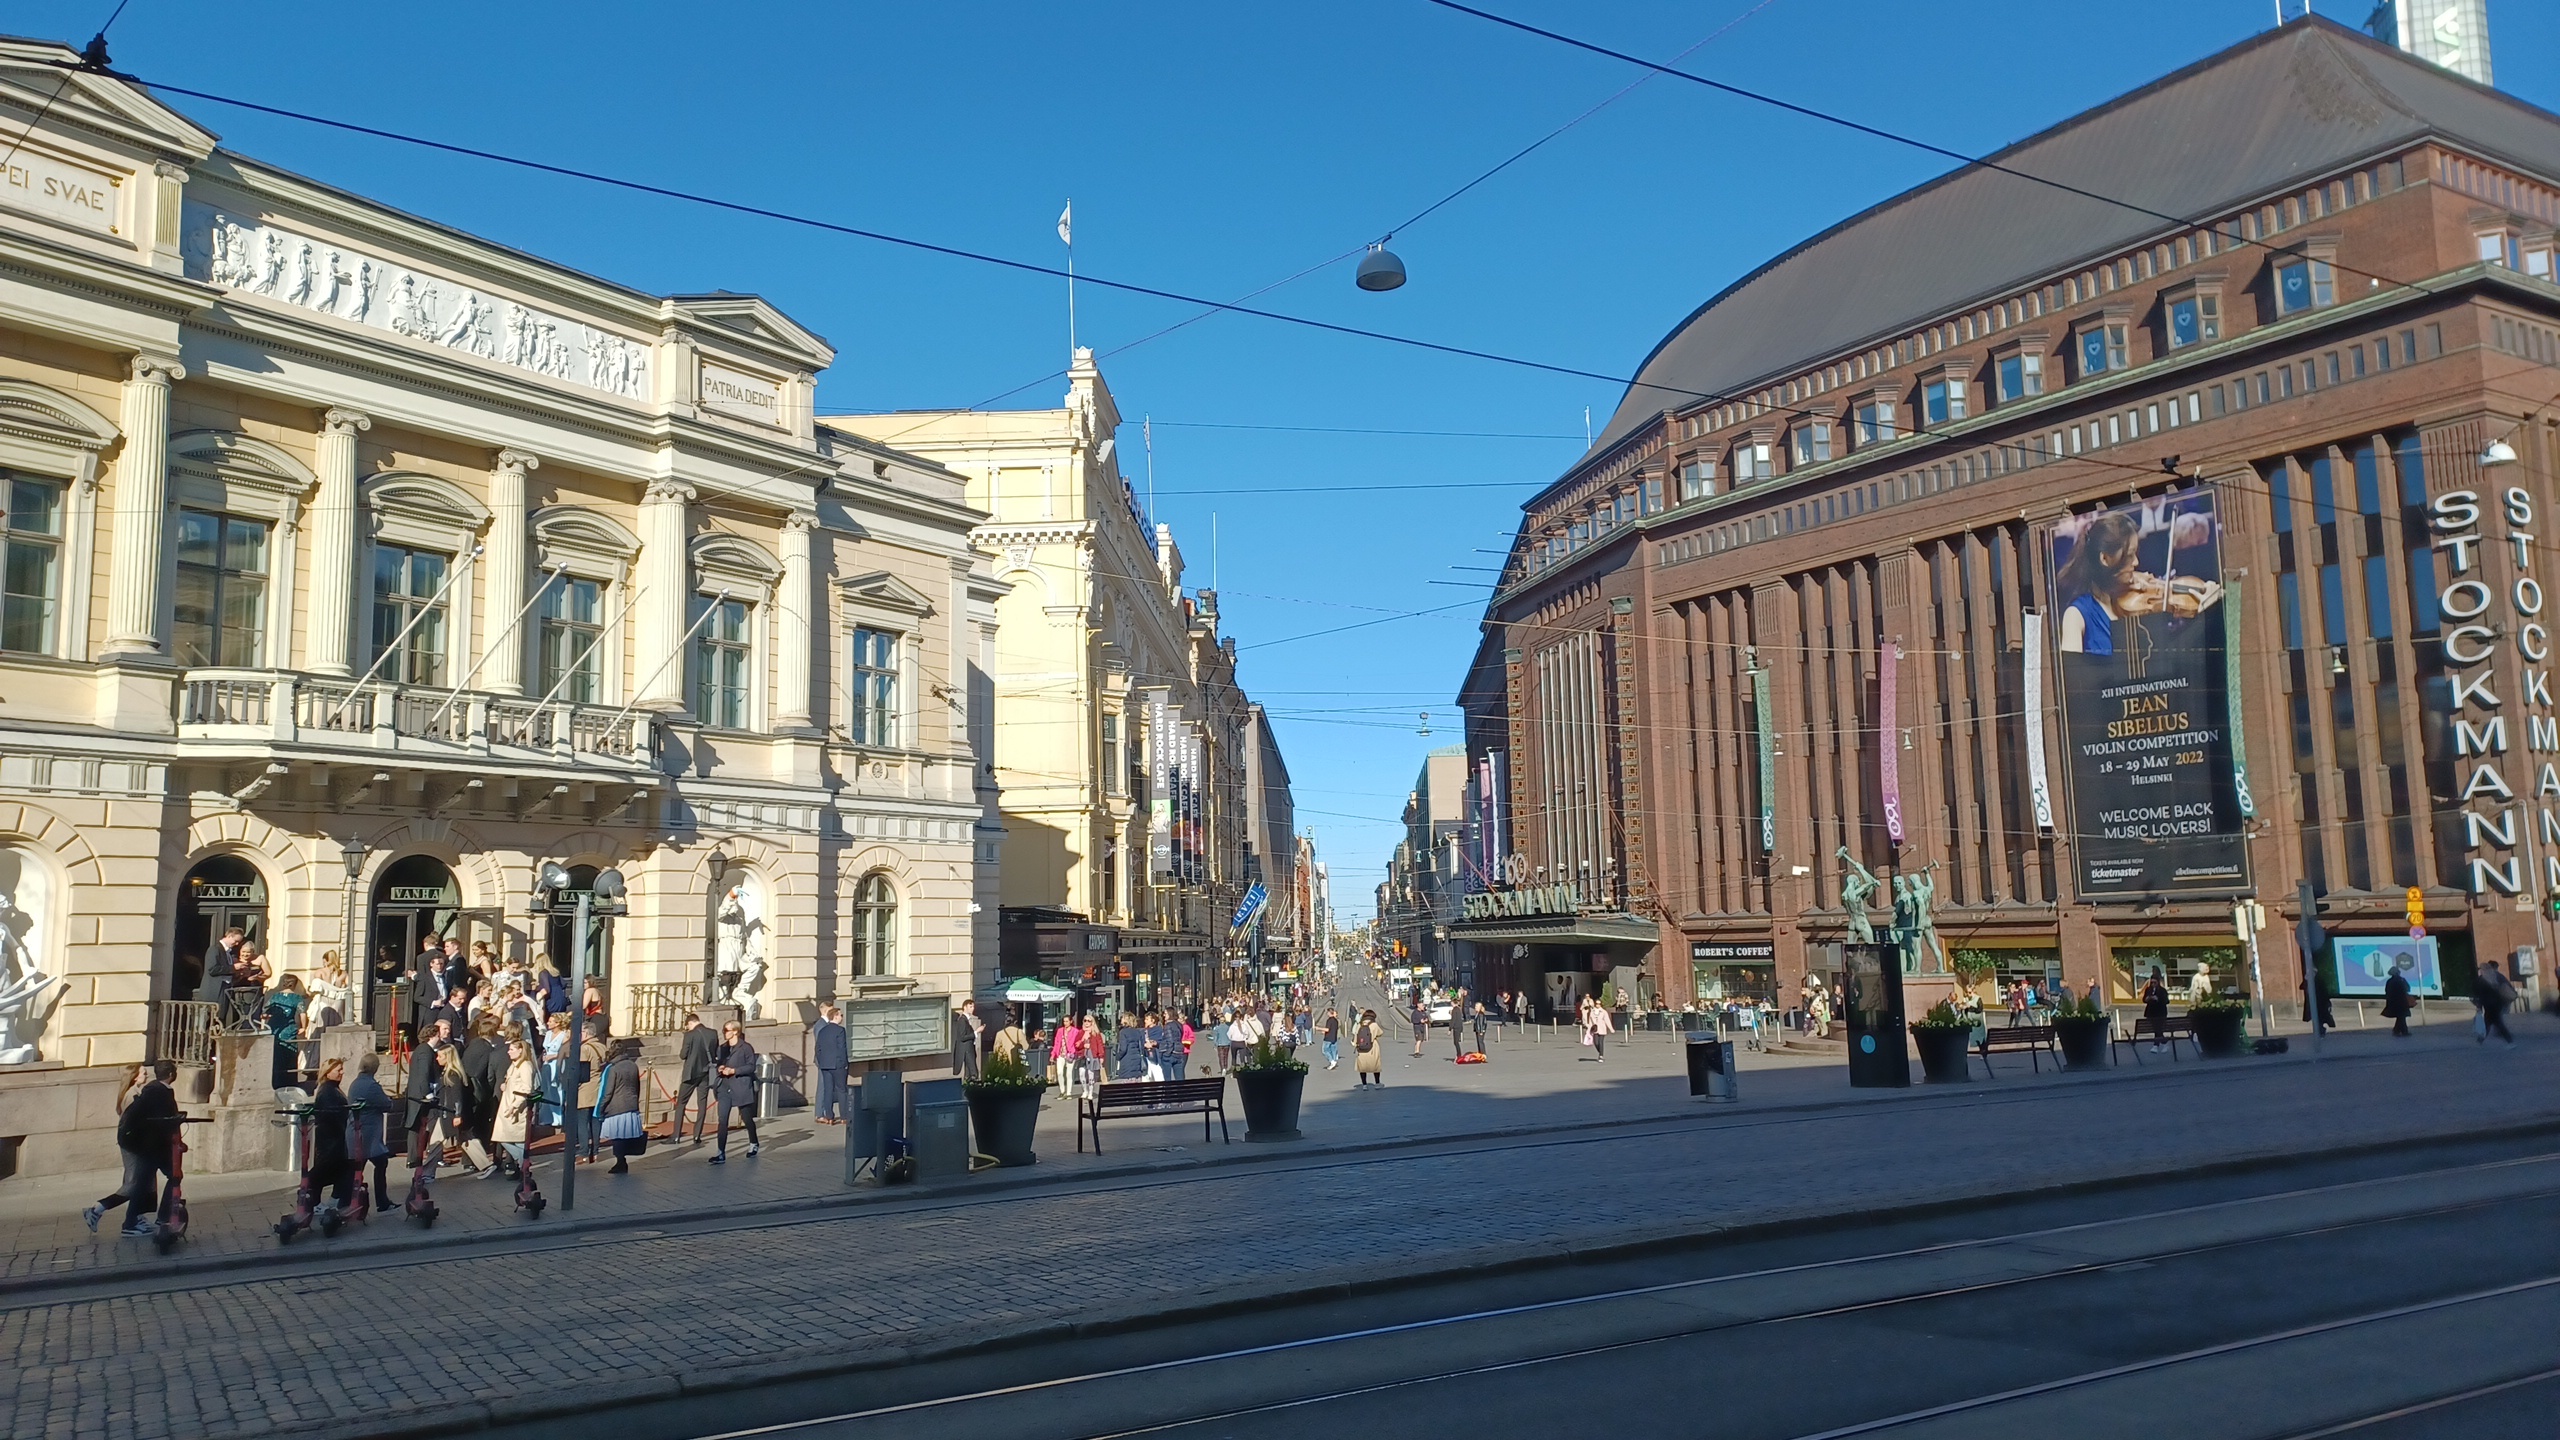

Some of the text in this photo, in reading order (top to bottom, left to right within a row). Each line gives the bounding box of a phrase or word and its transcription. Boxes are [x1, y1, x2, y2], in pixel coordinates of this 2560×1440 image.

[44, 176, 104, 211] SVAE
[704, 377, 775, 409] PATRIA DEDIT
[2101, 677, 2189, 698] XII INTERNATIONAL
[2434, 490, 2522, 893] STOCKMANN
[2122, 693, 2168, 719] JEAN
[1168, 721, 1176, 748] HARD
[2107, 712, 2189, 738] SIBELIUS
[1155, 703, 1165, 788] HARD ROCK CAFE
[2083, 729, 2219, 756] VIOLIN COMPETITION
[2100, 761, 2113, 773] 18
[2126, 760, 2140, 772] 29
[2175, 750, 2204, 765] 2022
[1169, 775, 1177, 800] CAFE
[2099, 802, 2213, 823] WELCOME BACK
[2104, 818, 2211, 839] MUSIC LOVERS!
[198, 886, 249, 897] VANHA
[395, 889, 439, 898] VANHA
[1462, 884, 1577, 919] STOCKMANN
[1694, 947, 1734, 956] ROBERT'S
